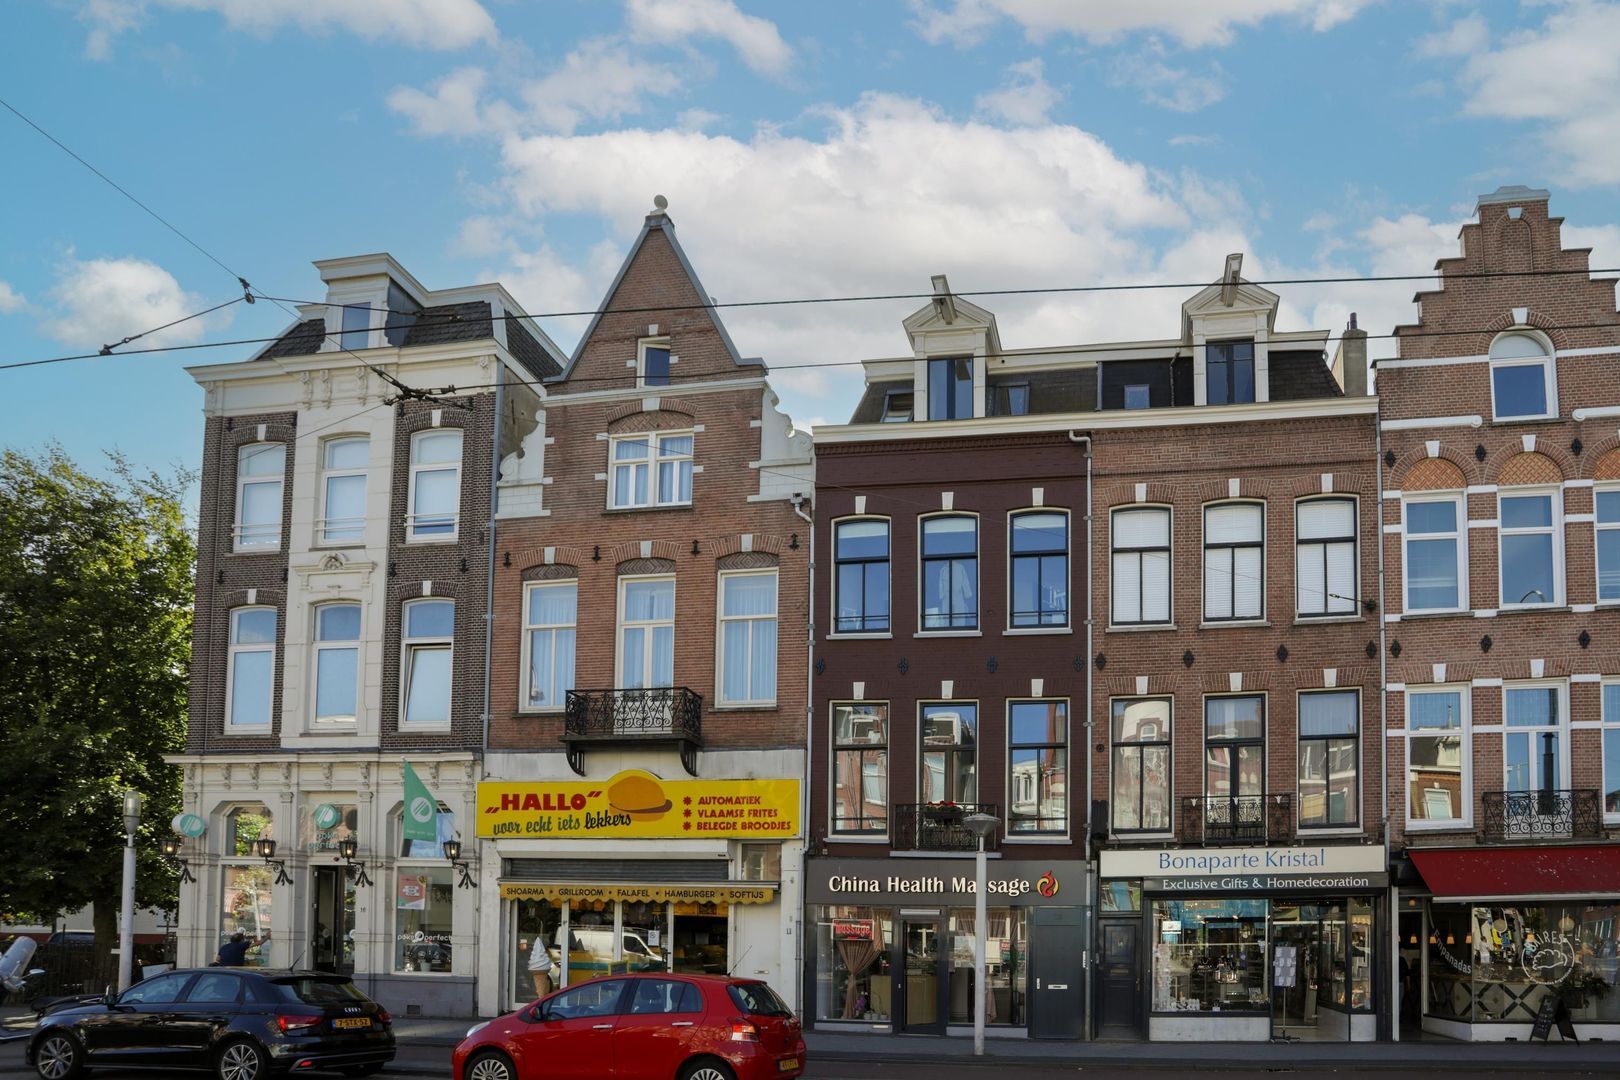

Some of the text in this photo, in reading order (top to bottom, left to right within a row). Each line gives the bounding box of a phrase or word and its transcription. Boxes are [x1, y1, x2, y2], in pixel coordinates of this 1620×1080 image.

[698, 796, 761, 805] AUTOMATIEK
[697, 808, 778, 818] VLAAMSE FRITES
[493, 809, 632, 836] voor echt iets lekkers
[696, 820, 792, 831] BELEGDE BROODJES
[1159, 848, 1325, 873] Bonaparte Kristal
[828, 875, 1030, 897] China Health Masage
[1162, 876, 1369, 890] Exclusive Gifts & Homedecoration
[506, 887, 764, 899] SHOARMA GRILLROOM FALAFEL HAMBURGER SOFTIJS
[1433, 929, 1472, 974] Empanadas
